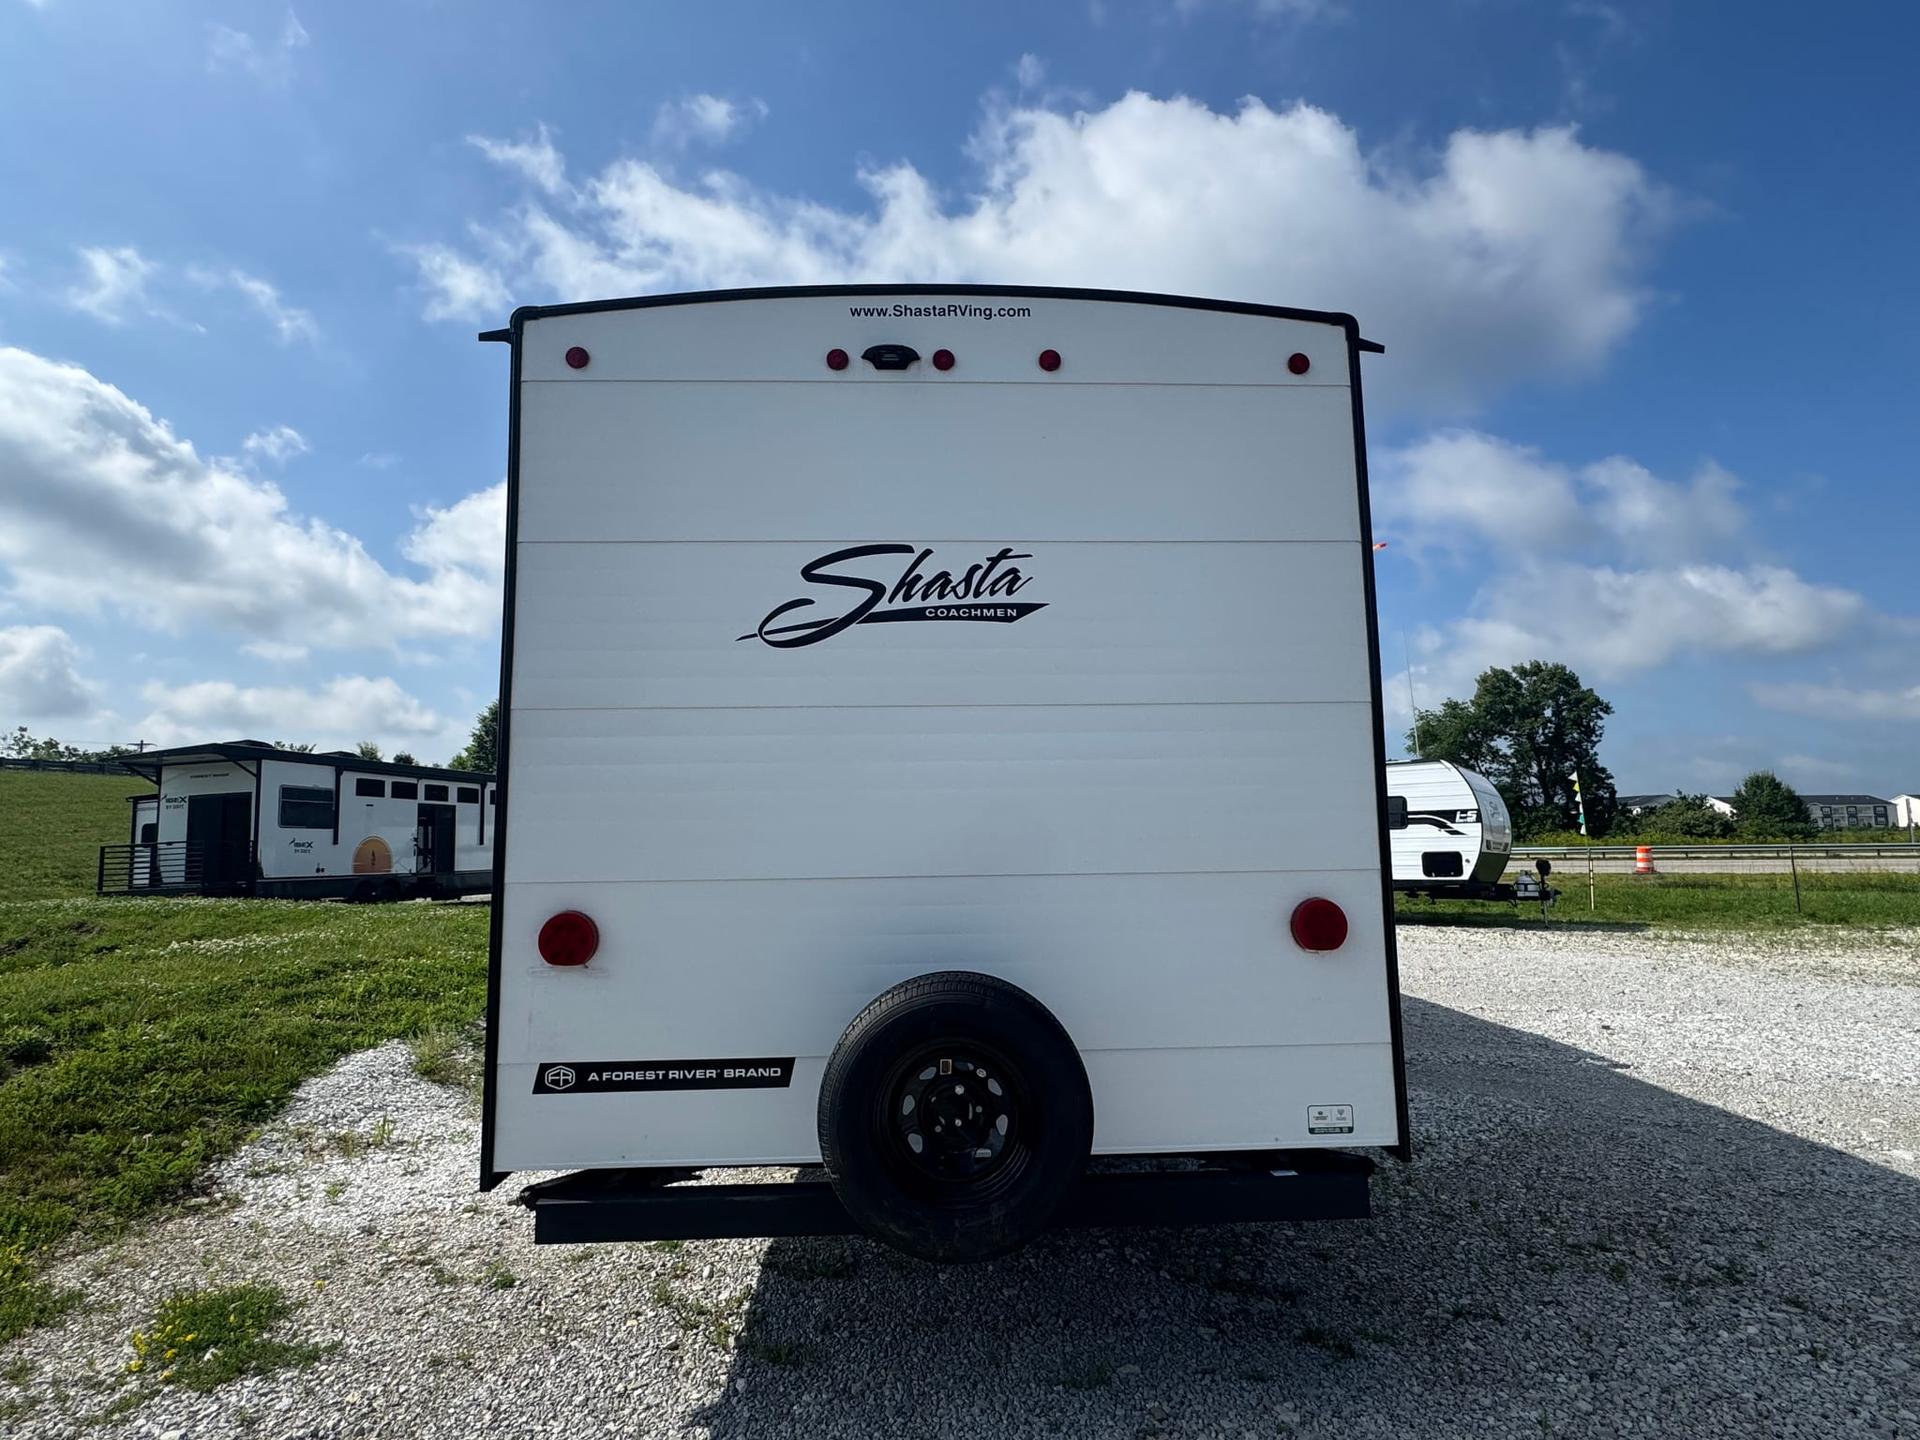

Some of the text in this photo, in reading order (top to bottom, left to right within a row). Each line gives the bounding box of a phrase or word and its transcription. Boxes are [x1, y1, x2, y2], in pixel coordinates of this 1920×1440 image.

[850, 304, 1031, 320] www.ShastaRVing.com
[750, 543, 1034, 649] Shasta
[925, 607, 1018, 618] COACHMEN
[587, 1072, 600, 1082] A
[602, 1070, 666, 1081] FOREST
[723, 1067, 782, 1077] BRAND
